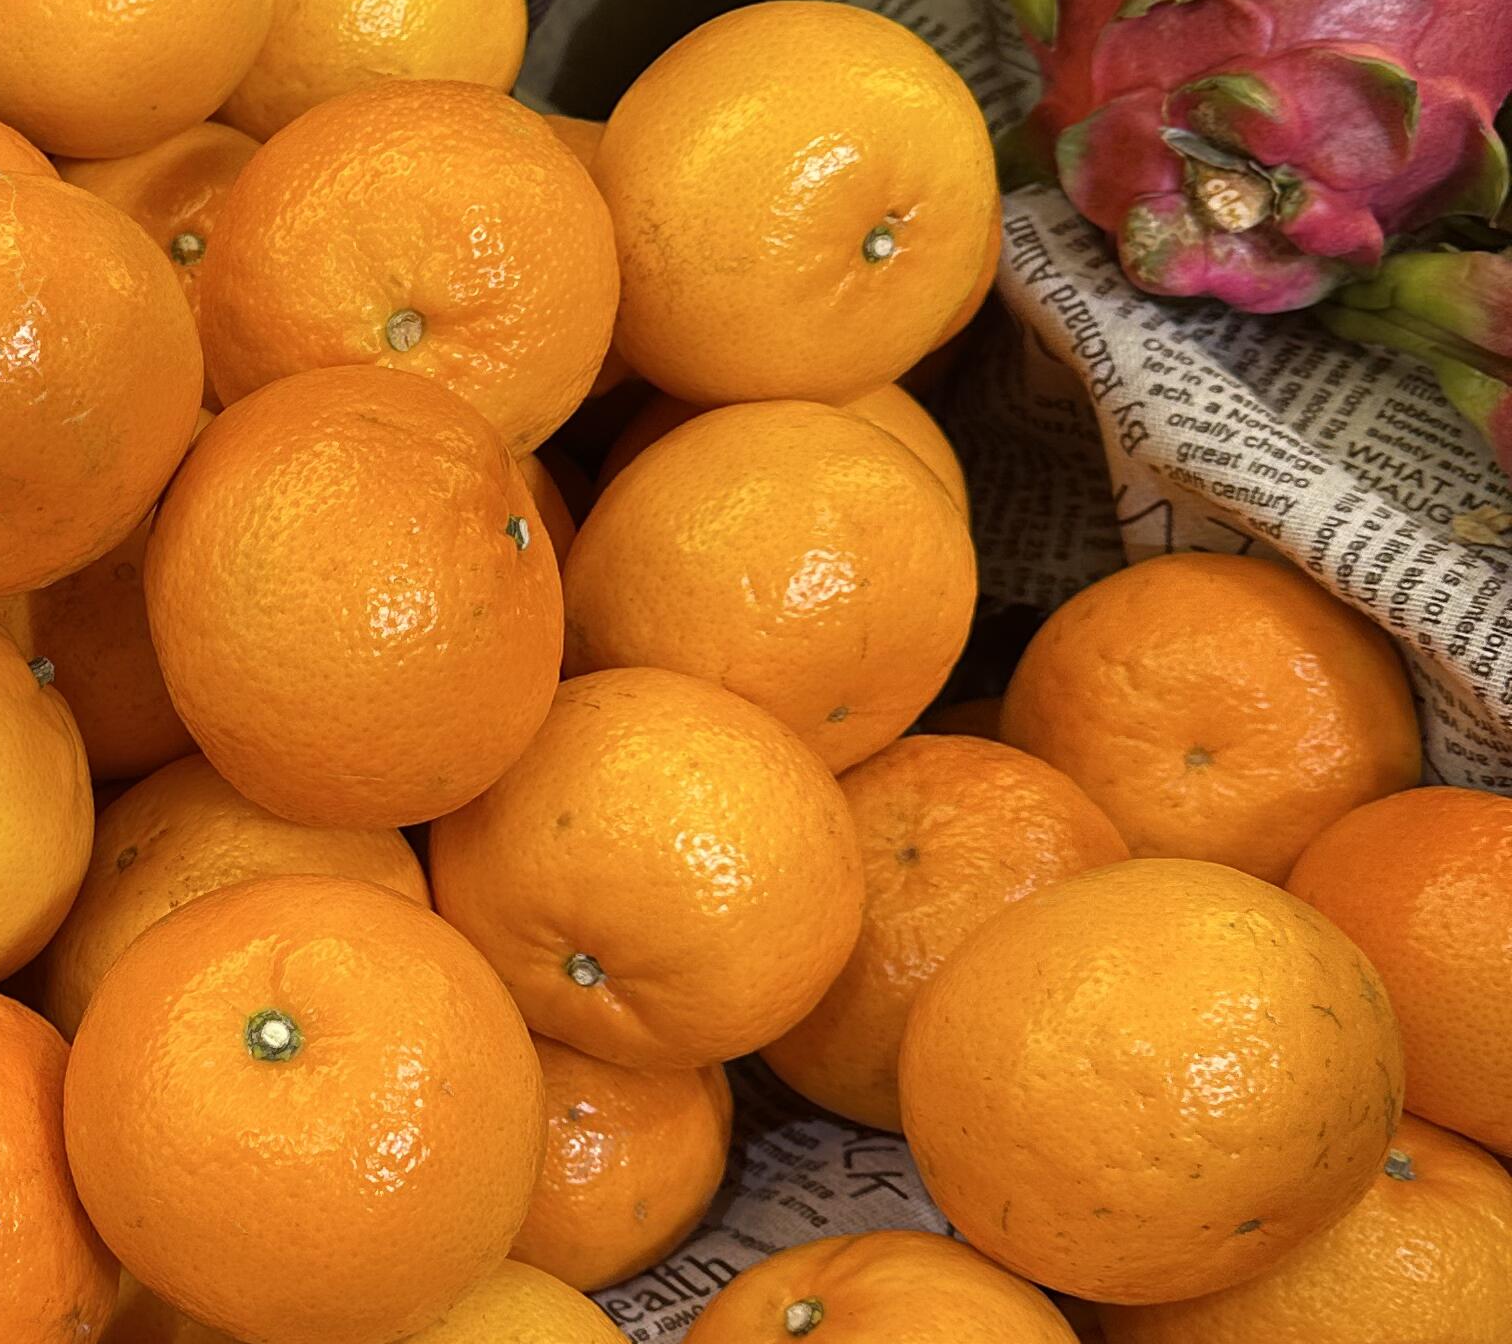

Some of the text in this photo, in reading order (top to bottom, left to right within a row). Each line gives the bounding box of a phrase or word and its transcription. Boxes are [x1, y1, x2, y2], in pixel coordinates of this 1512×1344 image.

[1005, 216, 1064, 286] Allan
[1041, 284, 1124, 404] Richard
[1112, 401, 1149, 456] By
[1176, 442, 1243, 469] great
[1243, 436, 1326, 475] charge
[1346, 441, 1454, 496] WHAT
[1211, 479, 1297, 516] century
[1389, 566, 1426, 629] about
[1420, 590, 1452, 626] not
[594, 1256, 740, 1327] ealth
